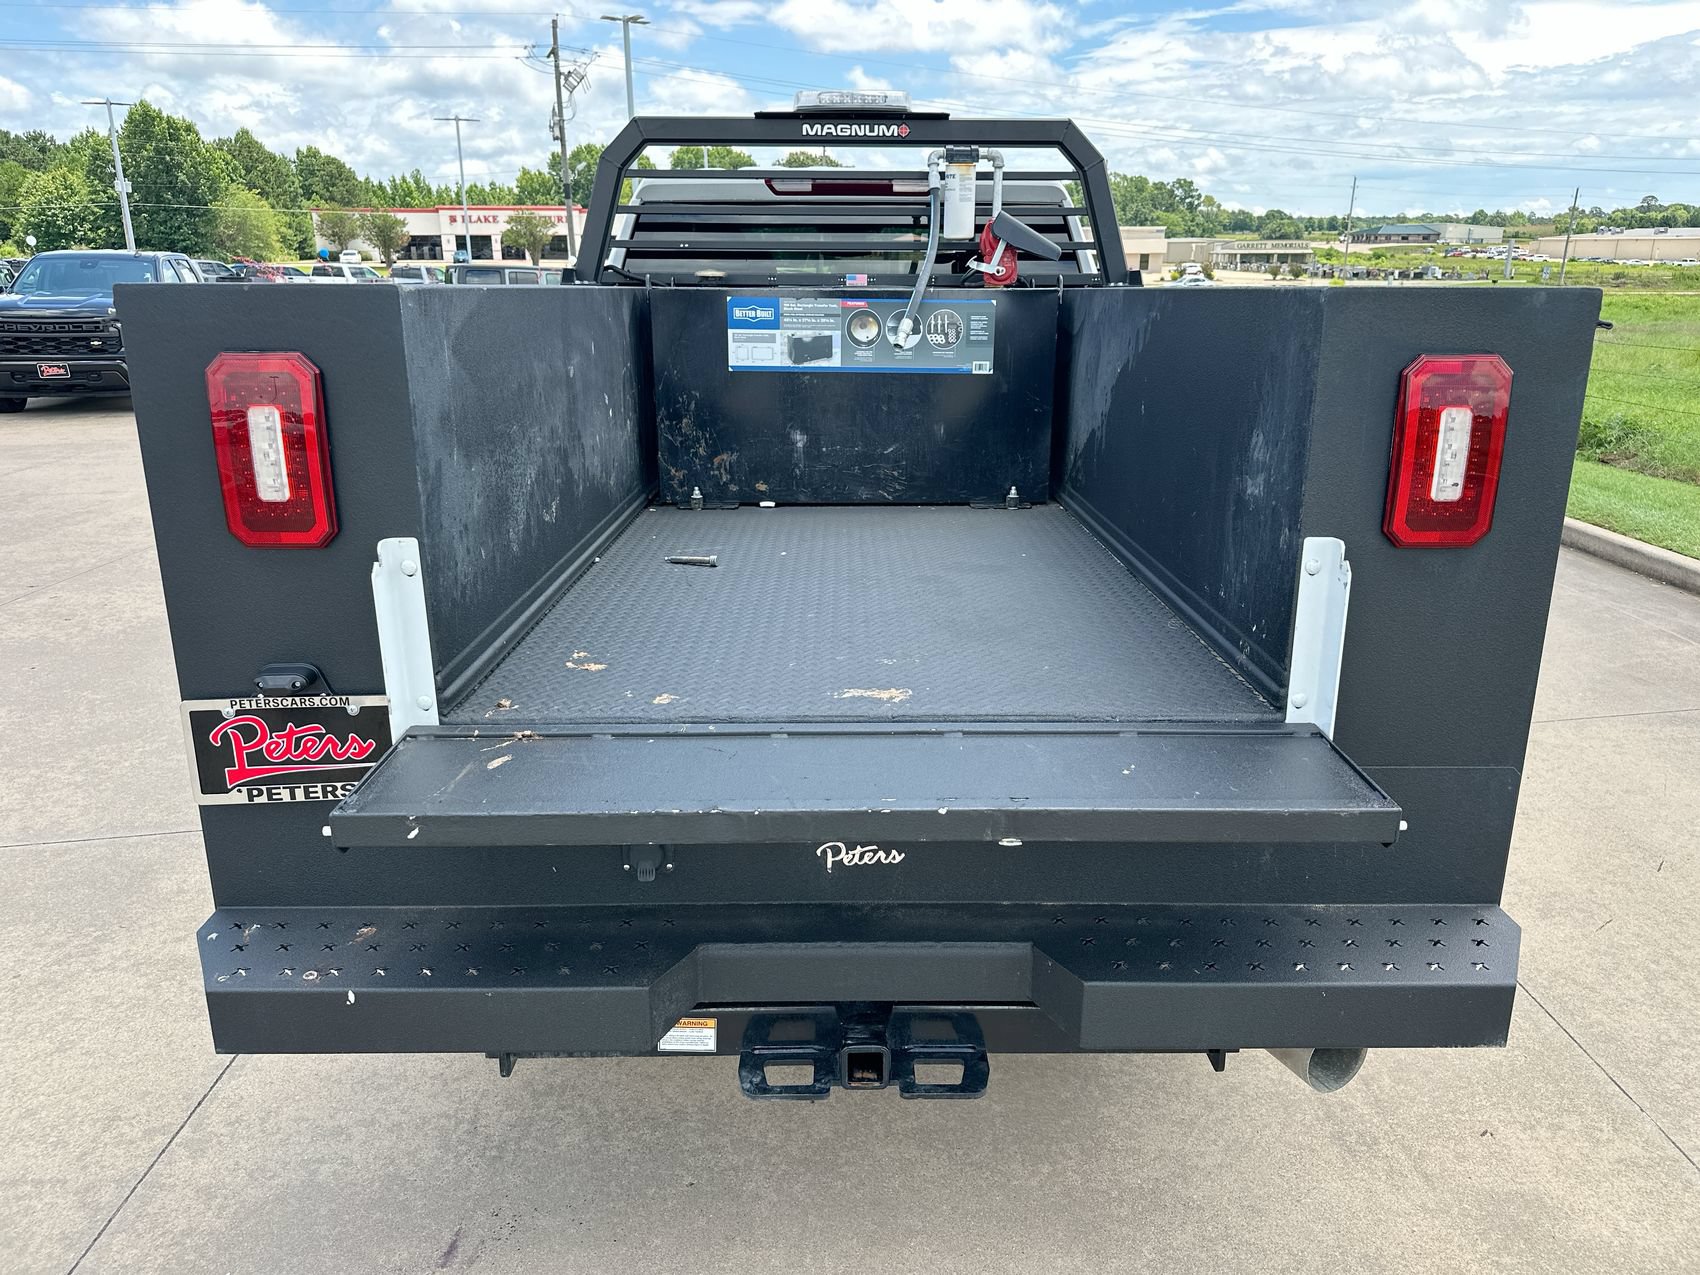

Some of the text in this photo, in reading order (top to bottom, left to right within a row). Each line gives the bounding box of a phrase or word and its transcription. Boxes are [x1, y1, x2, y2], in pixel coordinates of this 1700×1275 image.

[802, 124, 898, 136] MAGNUM
[230, 696, 350, 709] PETERSCARS.COM
[209, 715, 376, 789] Peters
[246, 783, 356, 802] PETERS
[815, 841, 906, 873] Peters
